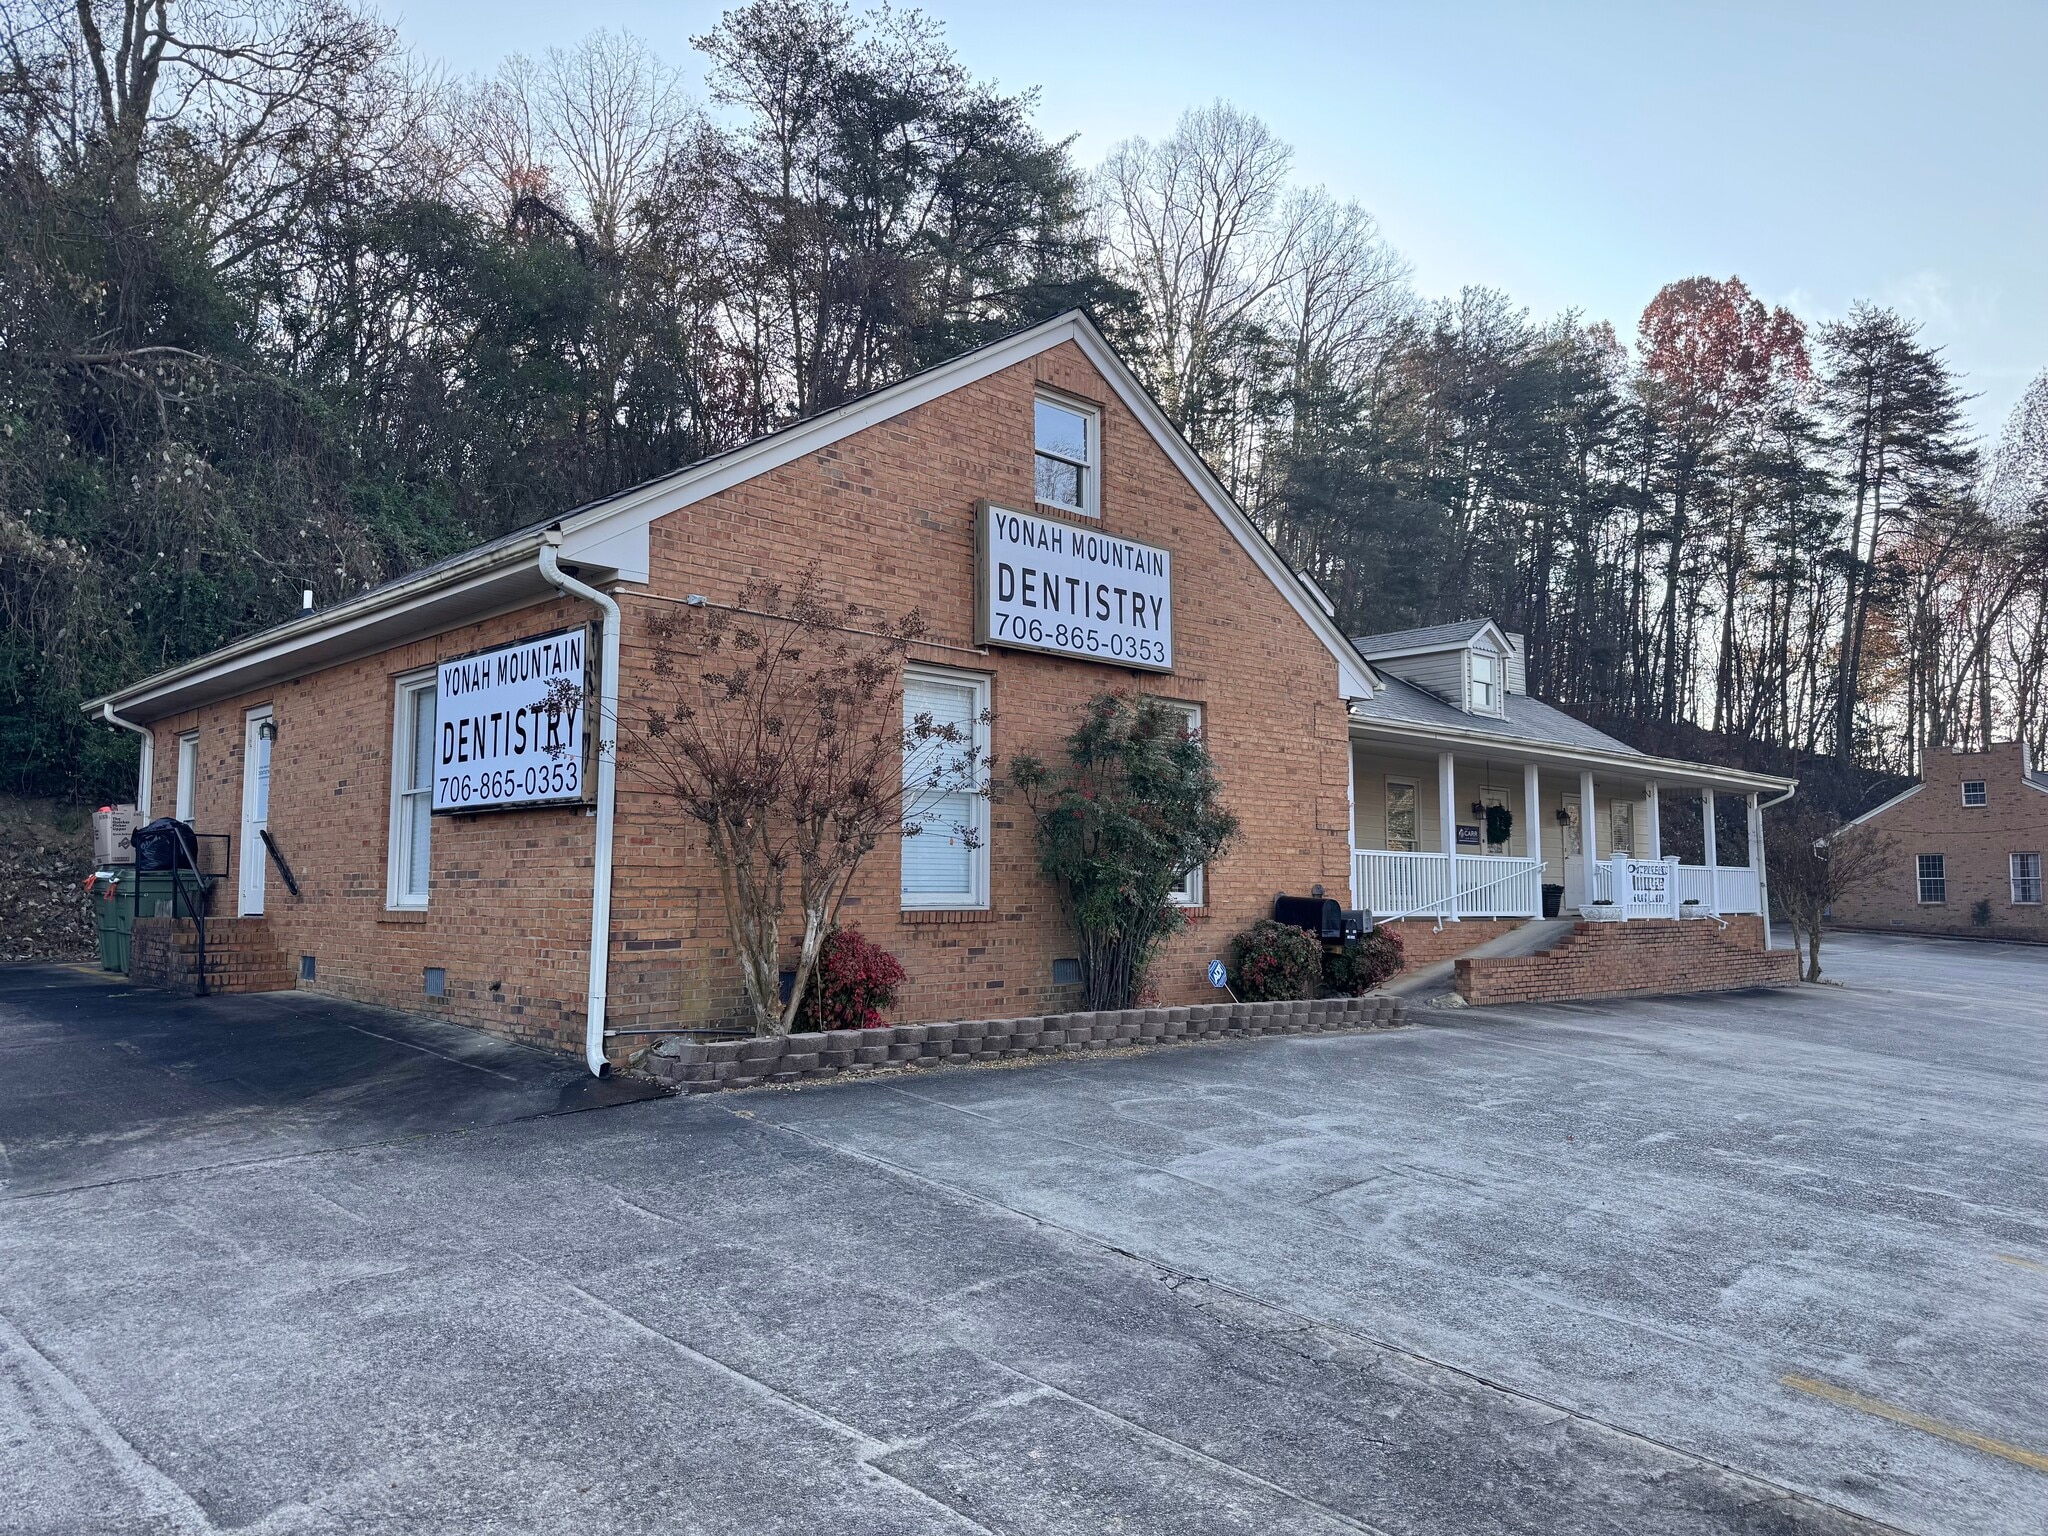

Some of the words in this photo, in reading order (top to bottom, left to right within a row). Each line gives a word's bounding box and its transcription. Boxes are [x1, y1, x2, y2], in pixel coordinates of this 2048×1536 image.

[995, 513, 1062, 553] YONAH
[1072, 532, 1163, 577] MOUNTAIN
[998, 562, 1163, 631] DENTISTRY
[444, 659, 490, 697] YONAH
[497, 637, 580, 687] MOUNTAIN
[995, 612, 1165, 663] 706-865-0353
[443, 703, 577, 765] DENTISTRY
[440, 761, 578, 804] 706-865-0353
